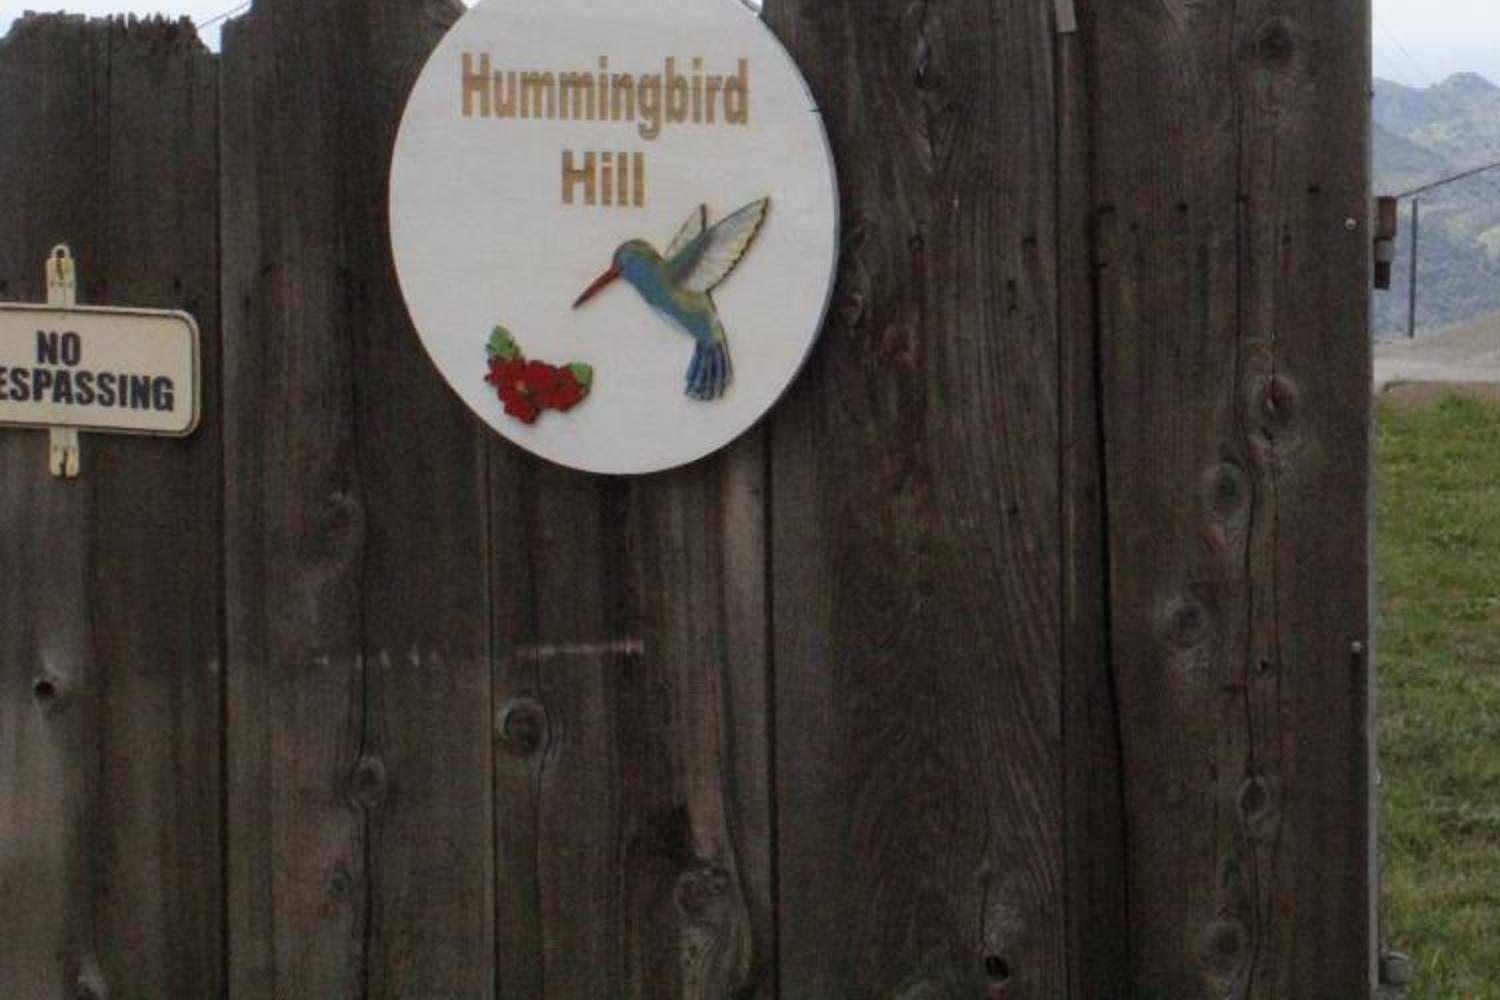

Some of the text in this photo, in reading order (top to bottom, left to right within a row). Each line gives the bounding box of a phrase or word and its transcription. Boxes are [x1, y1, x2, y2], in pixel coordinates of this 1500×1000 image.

[461, 53, 749, 140] Hummingbird
[561, 150, 645, 207] Hill
[36, 330, 81, 366] NO
